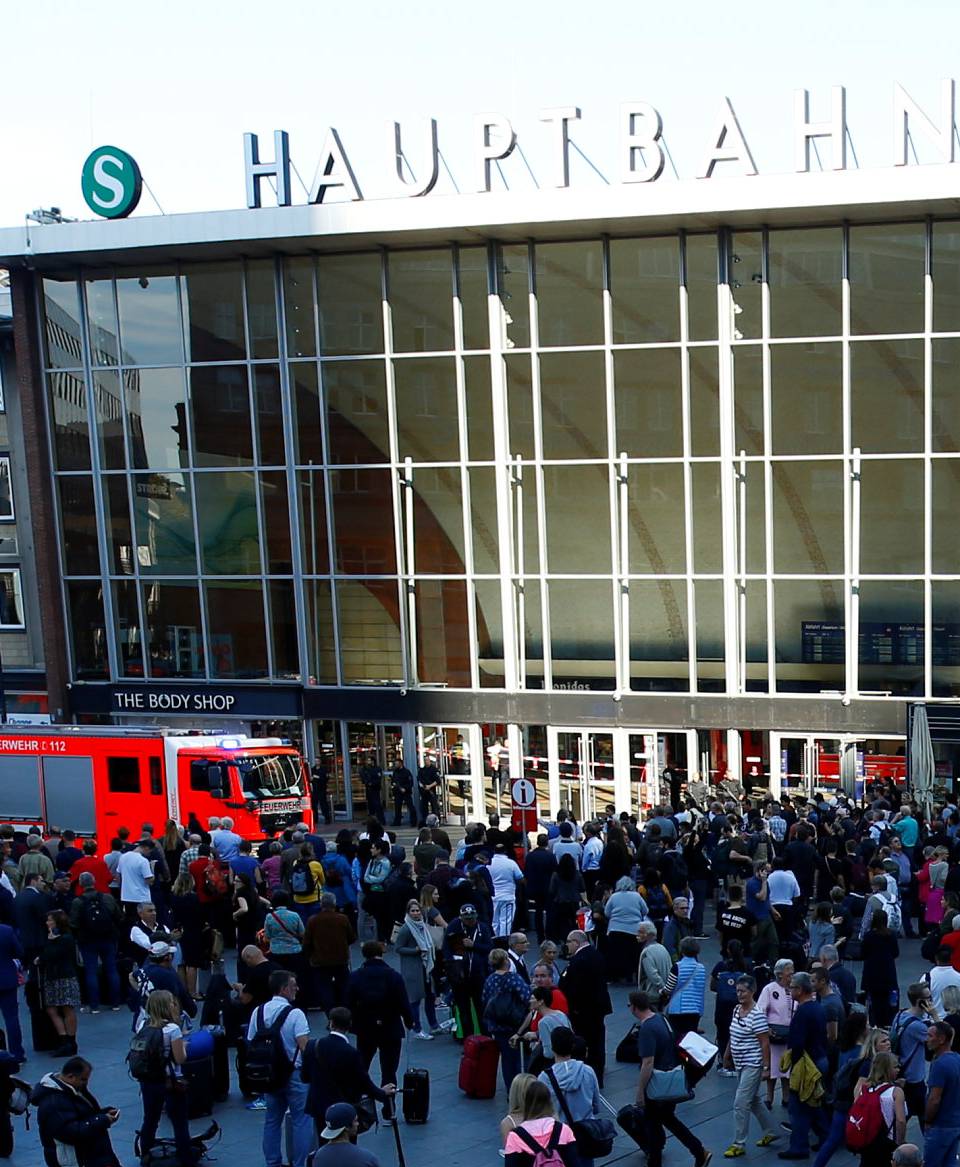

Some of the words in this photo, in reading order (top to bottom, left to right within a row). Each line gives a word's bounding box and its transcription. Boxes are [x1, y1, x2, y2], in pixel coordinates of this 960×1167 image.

[91, 154, 125, 208] S
[114, 693, 144, 708] THE
[149, 693, 190, 709] BODY
[194, 694, 235, 710] SHOP
[49, 741, 66, 751] 112
[260, 800, 301, 812] FEUERWEHR
